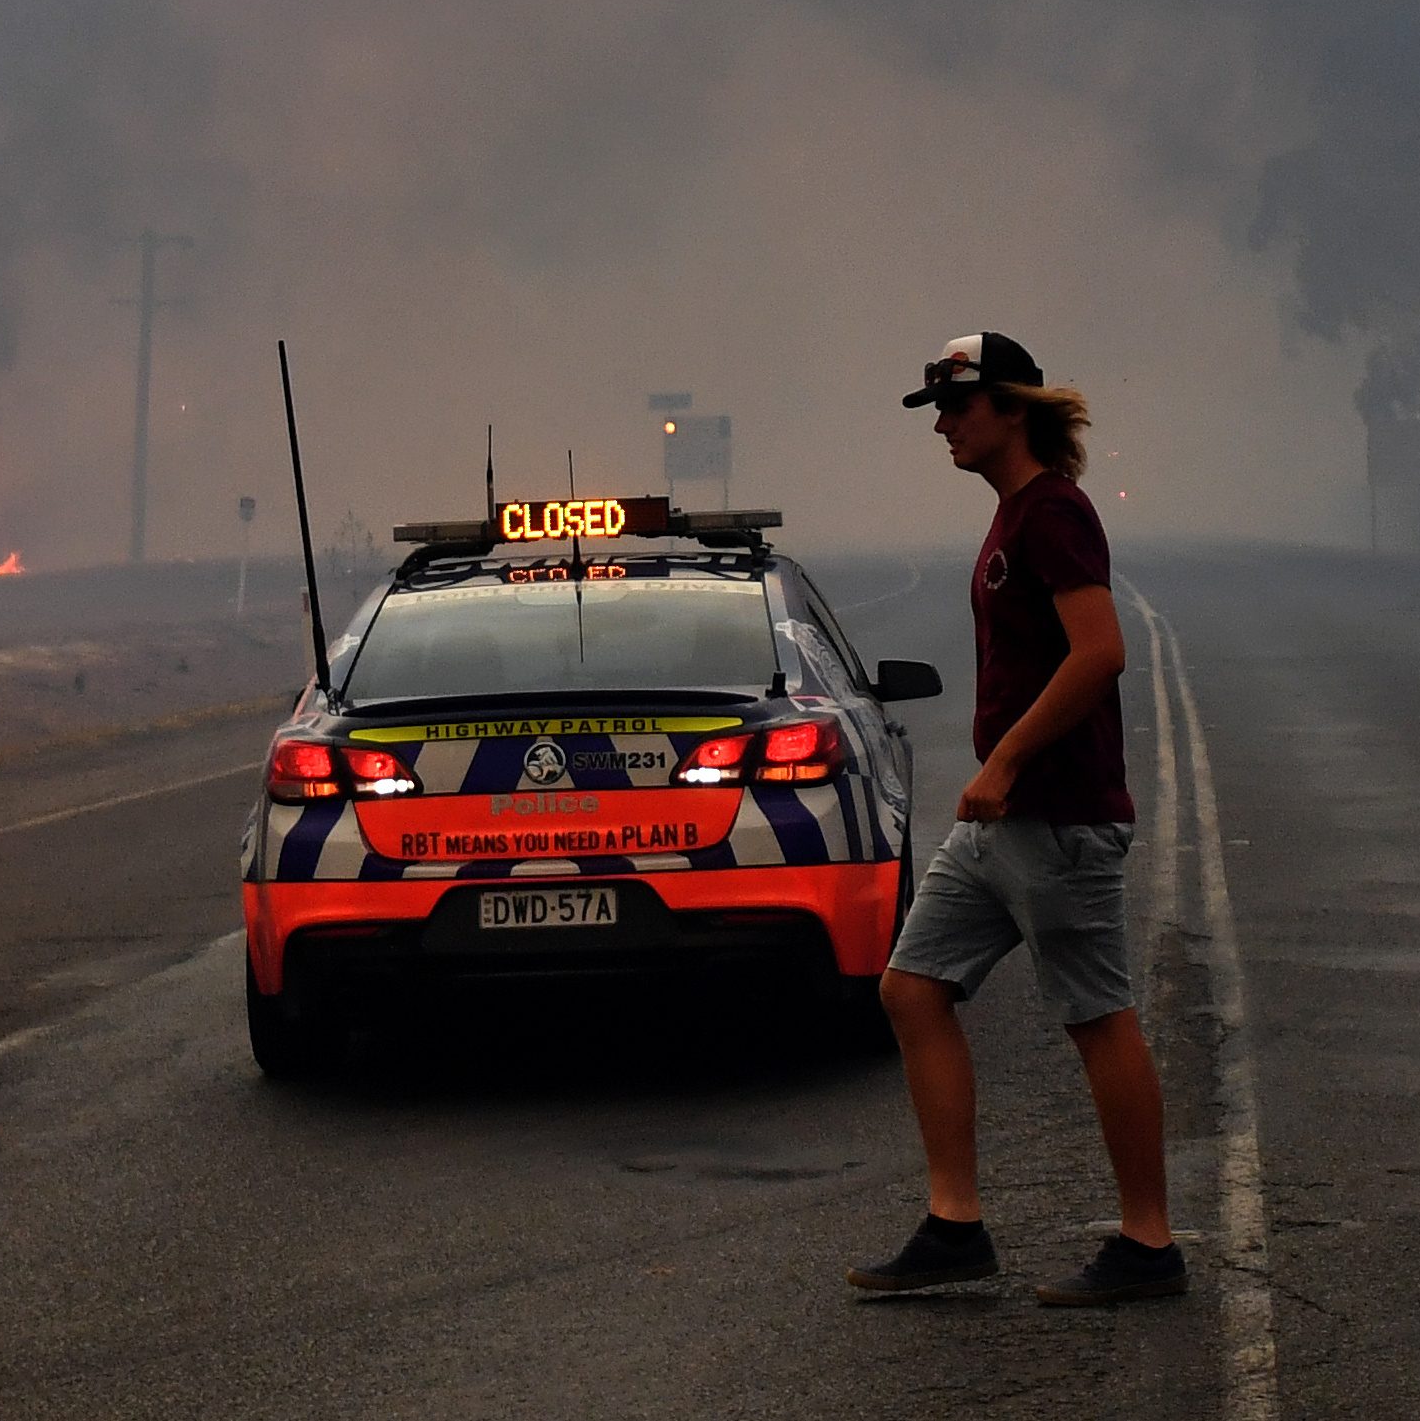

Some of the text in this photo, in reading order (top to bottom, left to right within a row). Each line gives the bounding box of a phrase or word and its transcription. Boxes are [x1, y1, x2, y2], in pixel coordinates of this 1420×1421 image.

[503, 499, 625, 539] CLOSED
[426, 718, 663, 738] HIGHWAY PATROL
[574, 752, 666, 770] SWM231
[490, 792, 600, 816] Police
[401, 823, 699, 857] RBT MEANS YOU NEED A PLAN B
